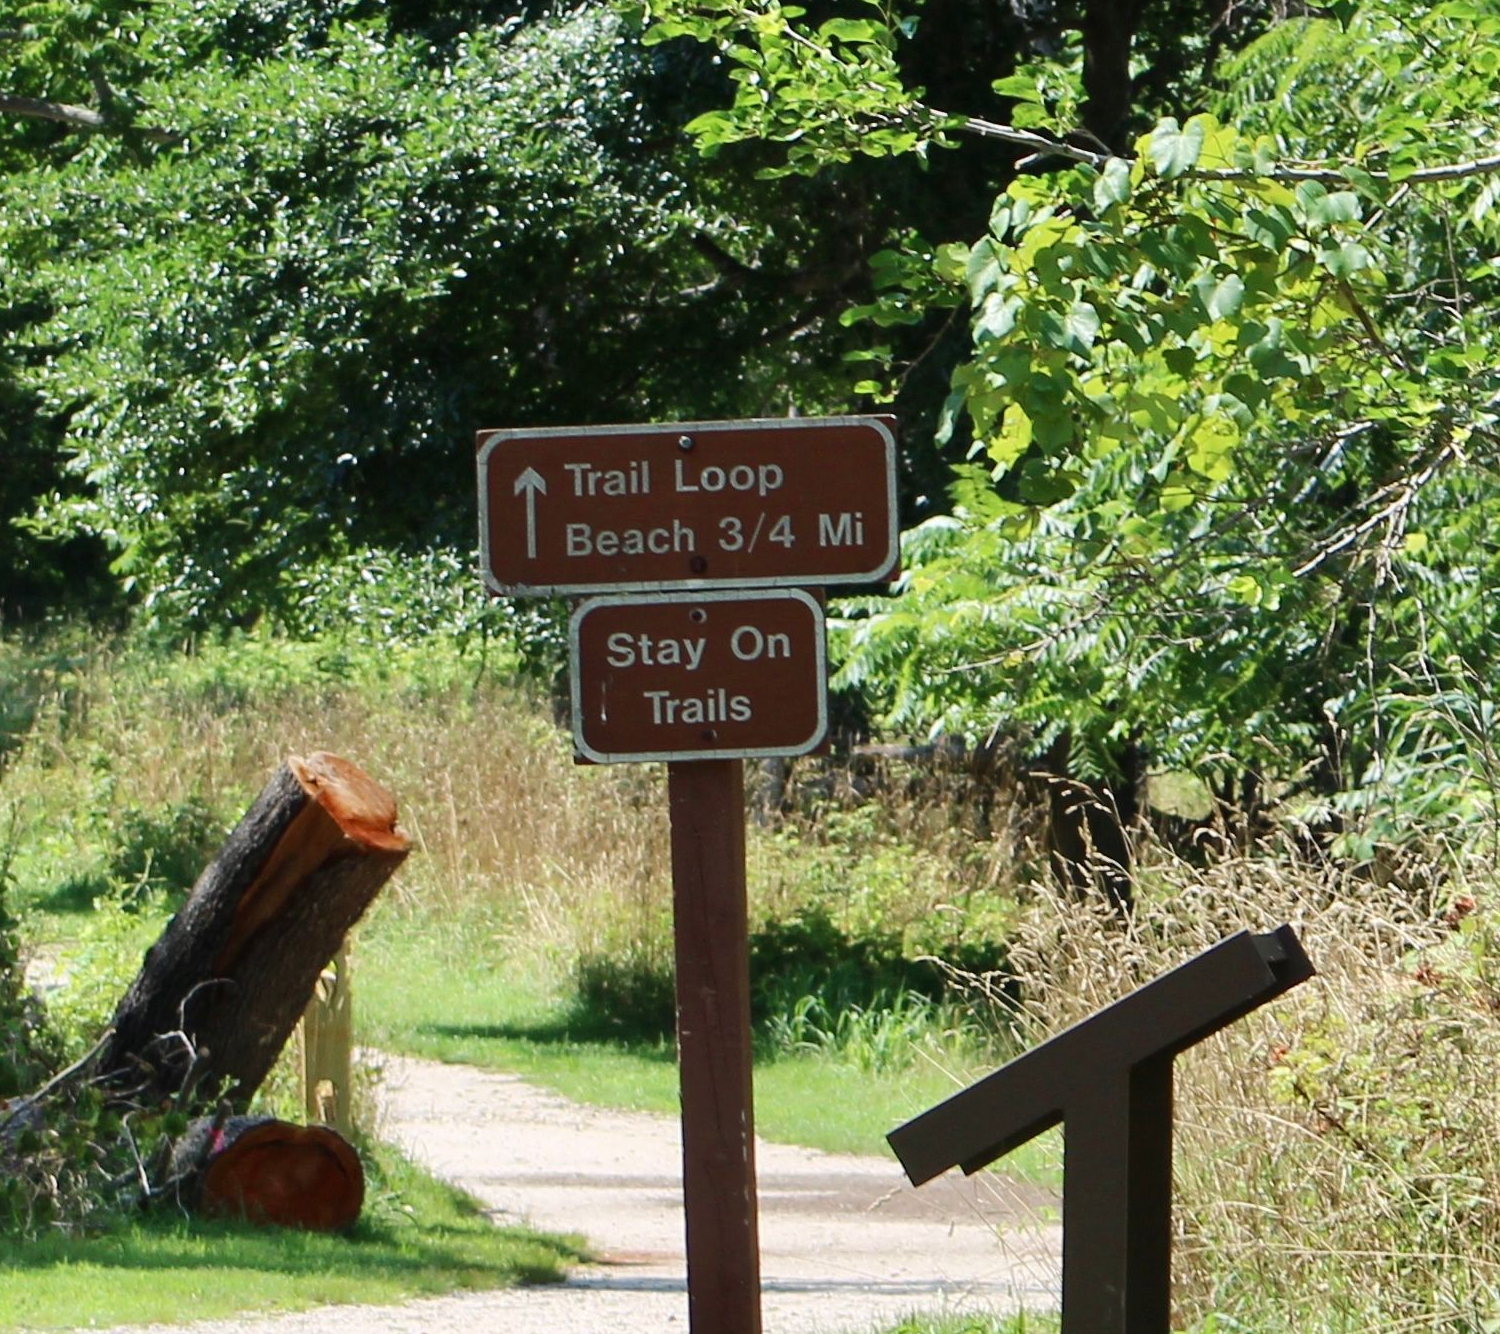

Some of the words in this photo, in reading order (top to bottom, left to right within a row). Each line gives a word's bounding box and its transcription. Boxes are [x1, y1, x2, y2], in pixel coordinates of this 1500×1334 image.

[563, 460, 650, 497] Trail
[674, 459, 784, 497] Loop
[566, 519, 695, 557] Beach
[718, 512, 796, 553] 3/4
[818, 511, 864, 547] Mi
[606, 632, 706, 671] Stay
[730, 625, 791, 661] On
[643, 688, 752, 725] Trails
